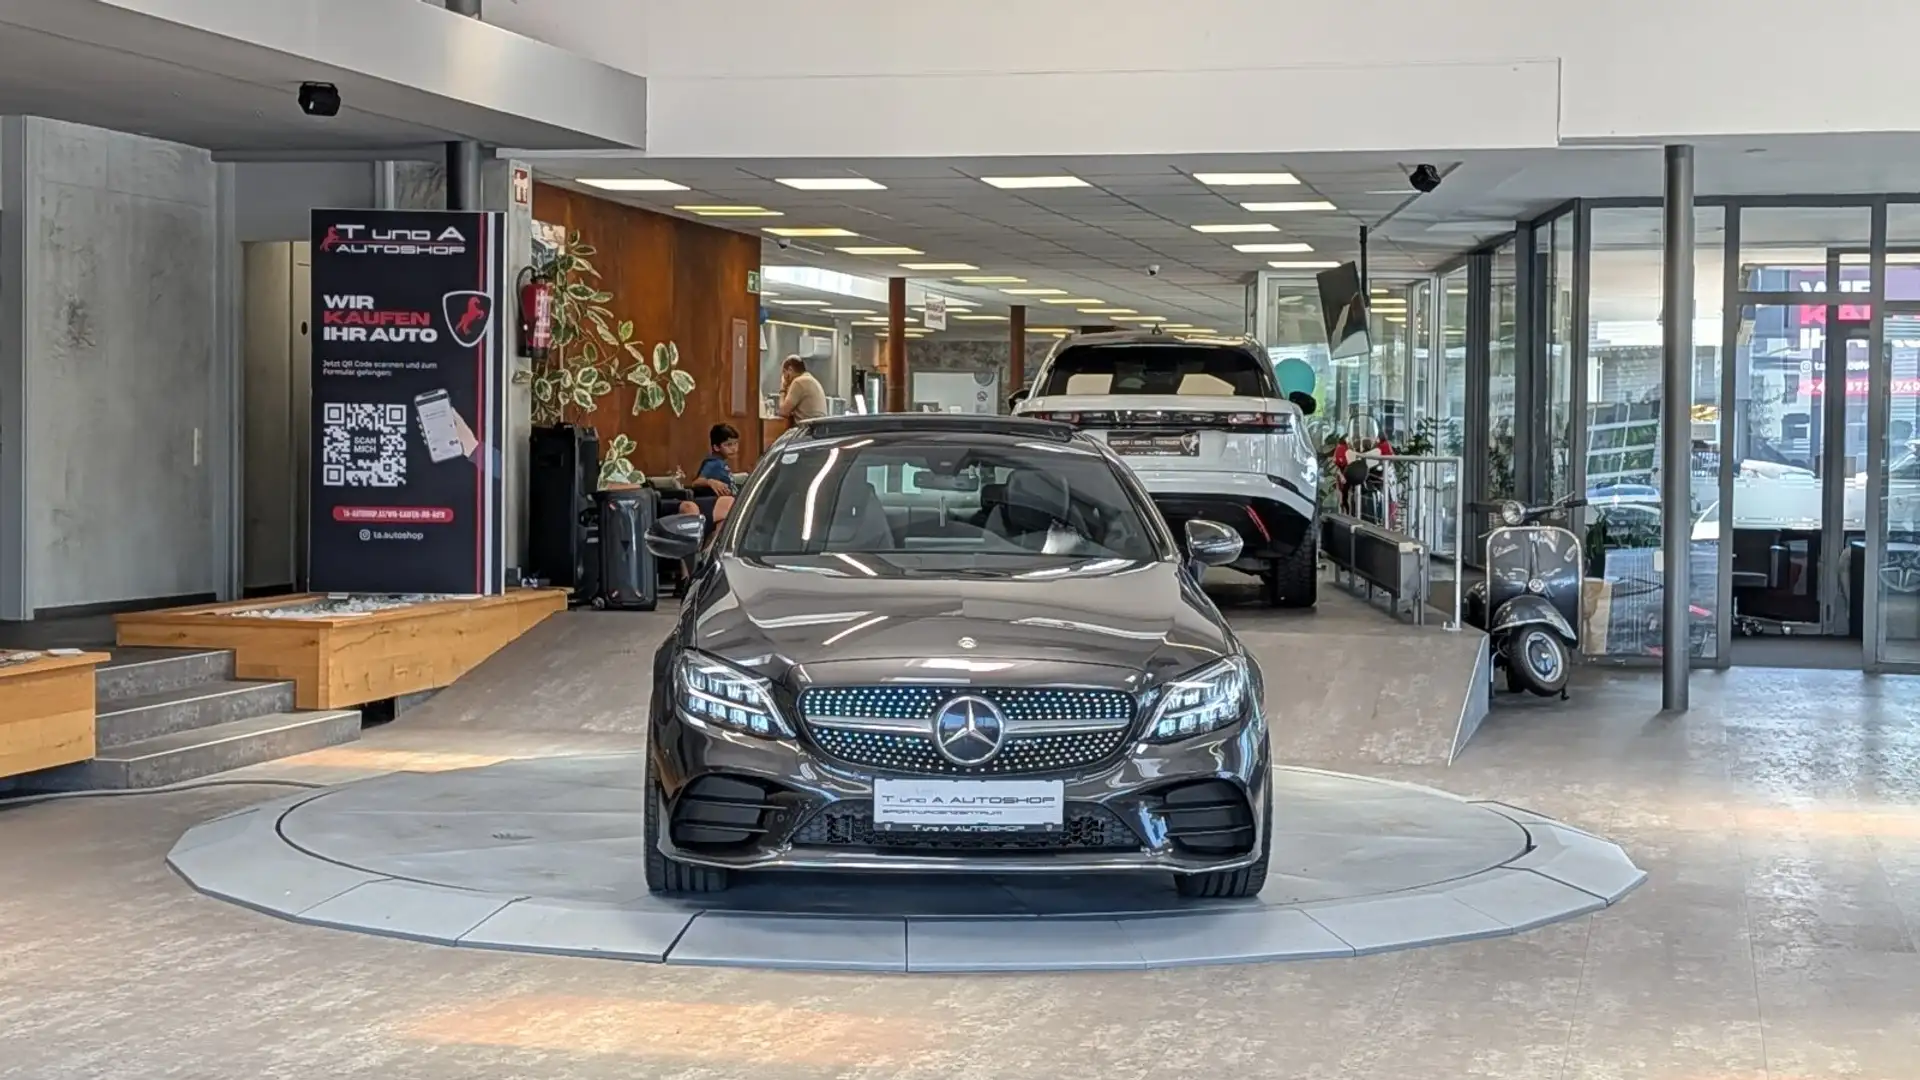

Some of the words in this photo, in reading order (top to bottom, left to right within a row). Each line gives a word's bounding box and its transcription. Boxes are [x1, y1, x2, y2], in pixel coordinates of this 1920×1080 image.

[335, 224, 365, 239] T
[436, 226, 466, 241] A
[335, 243, 466, 255] AUTOSHOP
[323, 294, 375, 309] WIR
[323, 310, 431, 326] KAUFEN
[323, 326, 367, 341] IHR
[369, 328, 438, 343] AUTO
[322, 360, 341, 368] Jetzt
[342, 360, 353, 368] QR
[354, 360, 373, 368] Code
[374, 361, 404, 369] scannen
[406, 361, 419, 369] und
[322, 368, 355, 376] Formular
[353, 436, 377, 445] SCAN
[353, 445, 377, 453] MICH
[949, 796, 1056, 804] AUTOSHOP
